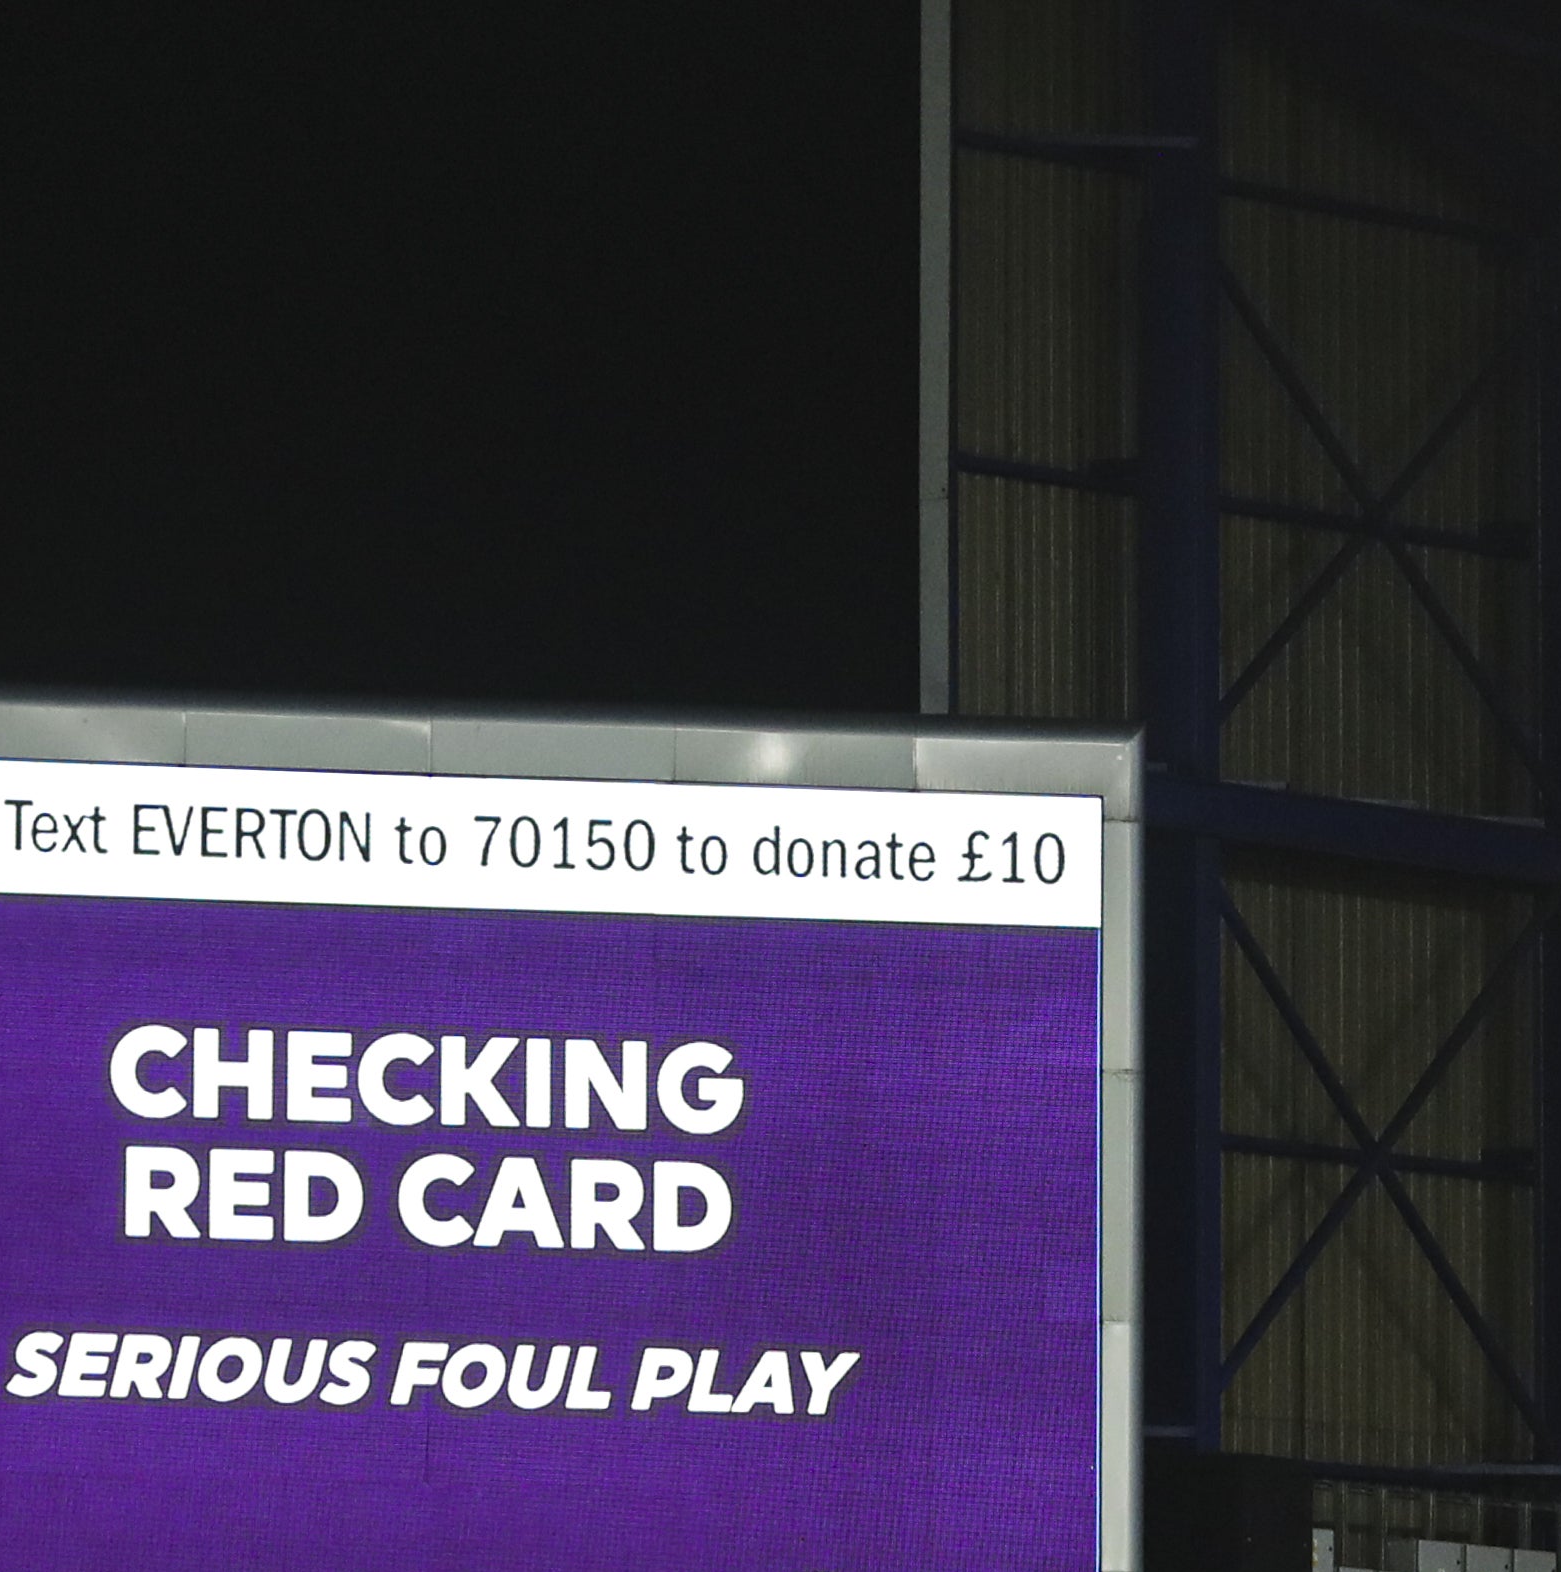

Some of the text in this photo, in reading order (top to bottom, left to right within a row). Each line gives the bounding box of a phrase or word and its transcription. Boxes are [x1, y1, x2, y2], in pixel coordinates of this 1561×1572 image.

[5, 800, 1067, 886] Text EVERTON to 70150 to donate £10
[109, 1023, 745, 1136] CHECKING
[123, 1144, 733, 1253] RED CARD
[5, 1331, 862, 1416] SERIOUS FOUL PLAY
